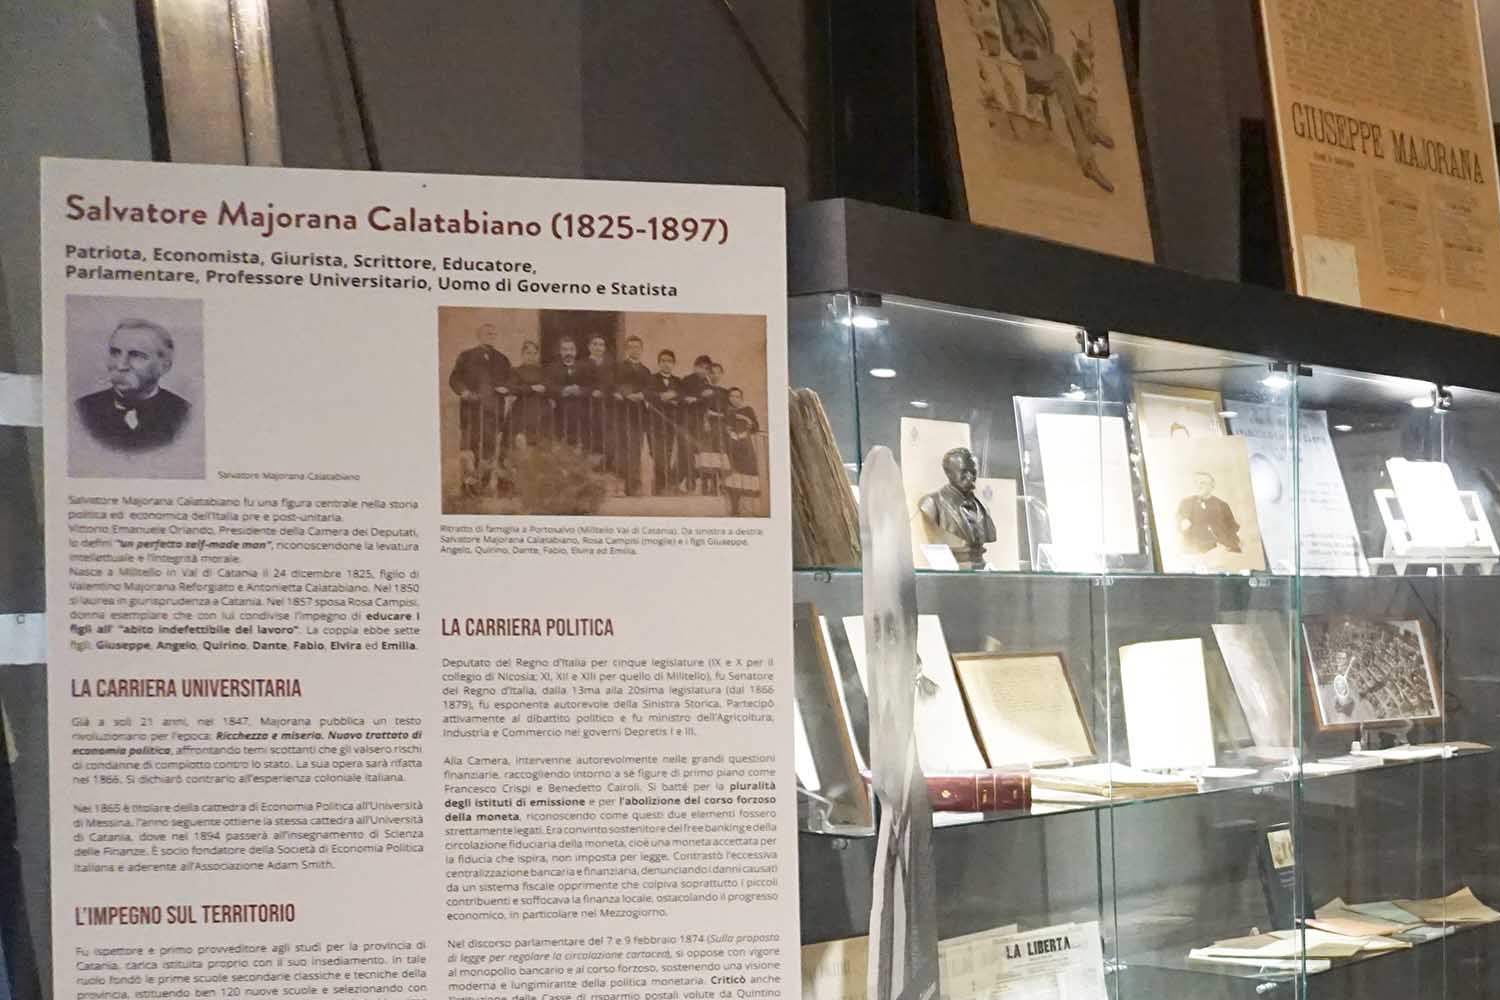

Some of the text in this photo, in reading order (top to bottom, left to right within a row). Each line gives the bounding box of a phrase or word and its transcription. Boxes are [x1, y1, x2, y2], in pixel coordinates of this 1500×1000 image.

[1291, 101, 1485, 184] GIUSEPPE MAJORANA
[65, 193, 728, 245] Salvatore Majorana Calatabiano (1825-1897)
[64, 244, 536, 275] Patriota, Economista, Giurista, Scrittore, Educatore,
[64, 264, 677, 296] Parlamentare, Professore Universitario, Uomo di Governo e Statista
[441, 617, 614, 636] LA CARRIERA POLITICA
[71, 678, 301, 698] LA CARRIERA UNIVERSITARIA
[444, 798, 471, 810] degli
[474, 798, 512, 808] istituti
[515, 797, 526, 807] di
[529, 798, 585, 807] emissione
[598, 799, 614, 807] per
[619, 796, 681, 806] l'abolizione
[683, 796, 700, 805] del
[736, 794, 776, 804] forzoso
[74, 903, 295, 926] L'IMPEGNO SUL TERRITORIO
[1006, 944, 1022, 959] LA
